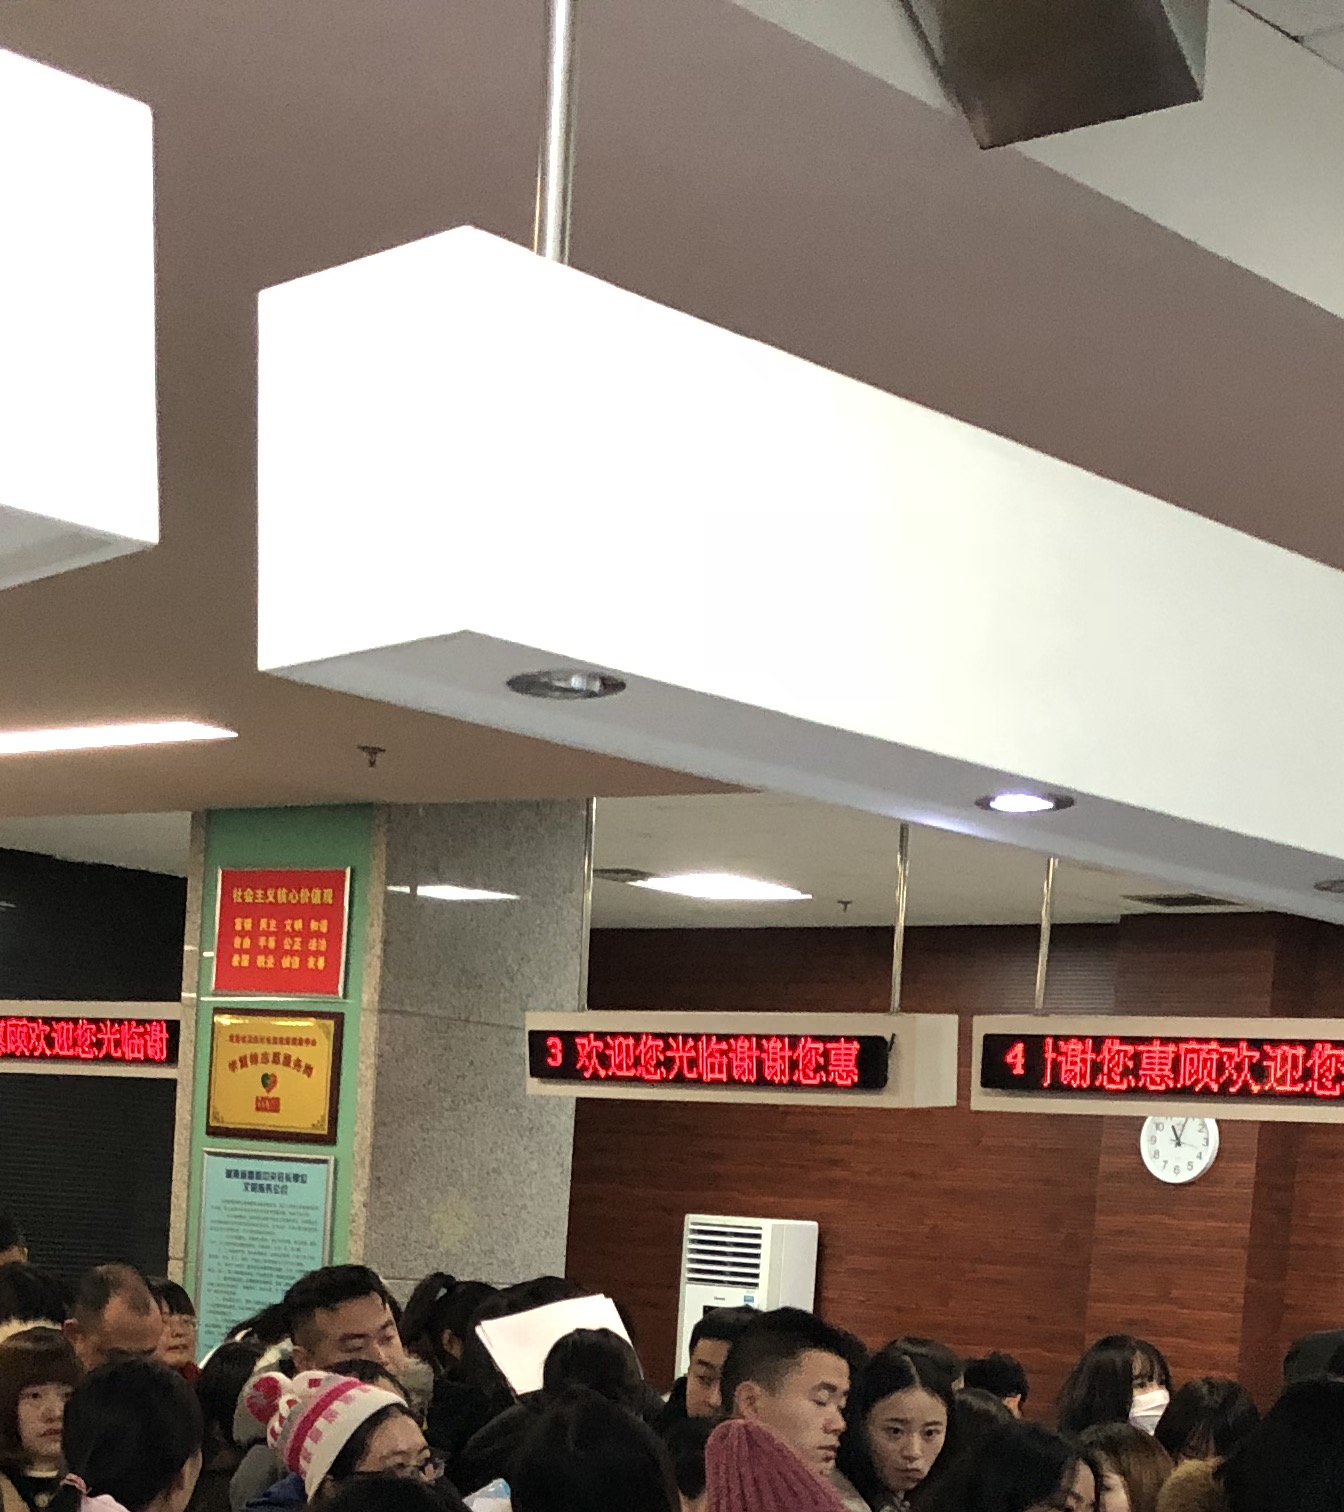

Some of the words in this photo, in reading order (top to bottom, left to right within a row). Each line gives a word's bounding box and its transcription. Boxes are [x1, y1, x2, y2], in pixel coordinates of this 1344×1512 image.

[233, 887, 333, 905] 社会主义核心价值观
[546, 1037, 563, 1067] 3
[574, 1033, 860, 1086] 欢迎您光临谢谢您惠
[1005, 1042, 1025, 1075] 4
